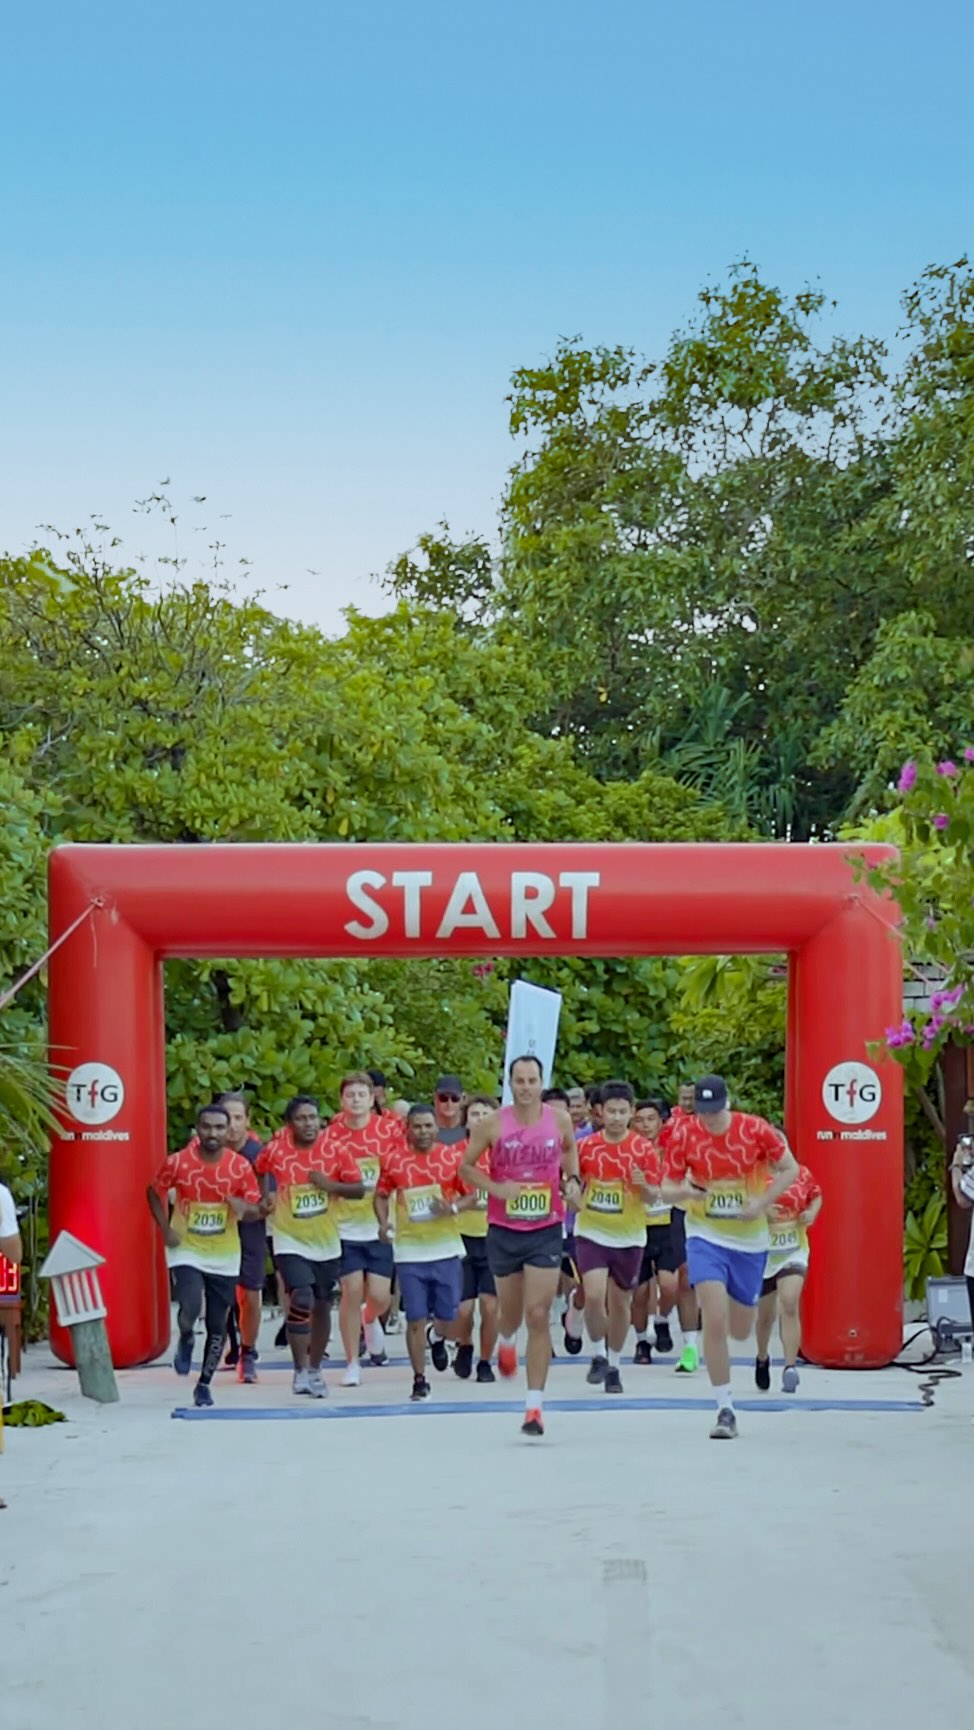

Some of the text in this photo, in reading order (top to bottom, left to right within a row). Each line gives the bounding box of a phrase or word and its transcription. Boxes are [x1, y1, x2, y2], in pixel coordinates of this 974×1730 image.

[344, 869, 600, 940] START
[71, 1079, 118, 1109] TfG
[828, 1078, 876, 1108] TfG
[295, 1191, 326, 1210] 2035
[511, 1193, 546, 1211] 3000
[590, 1188, 620, 1205] 2040
[710, 1191, 743, 1209] 2029
